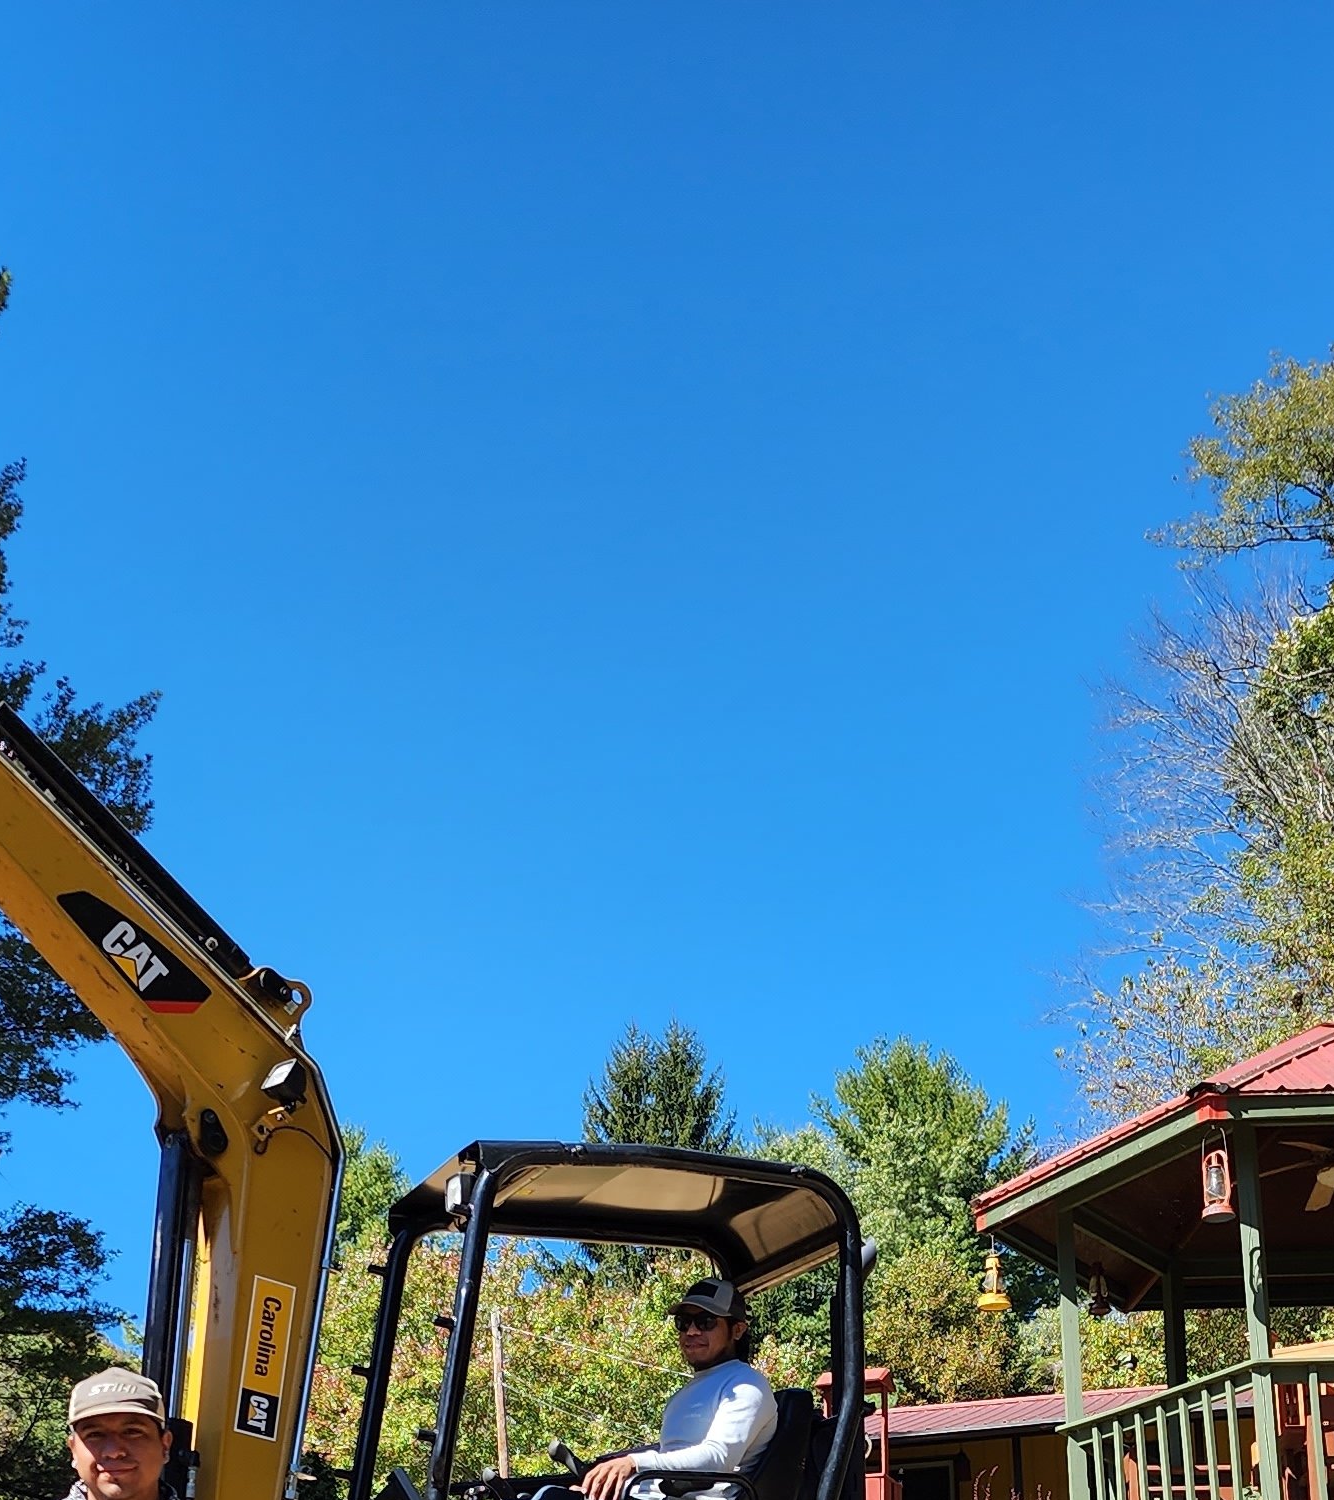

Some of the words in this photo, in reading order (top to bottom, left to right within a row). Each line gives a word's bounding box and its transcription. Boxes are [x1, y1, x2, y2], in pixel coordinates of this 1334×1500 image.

[102, 921, 169, 992] CAT
[254, 1296, 282, 1377] Carolina
[247, 1395, 270, 1432] CAT
